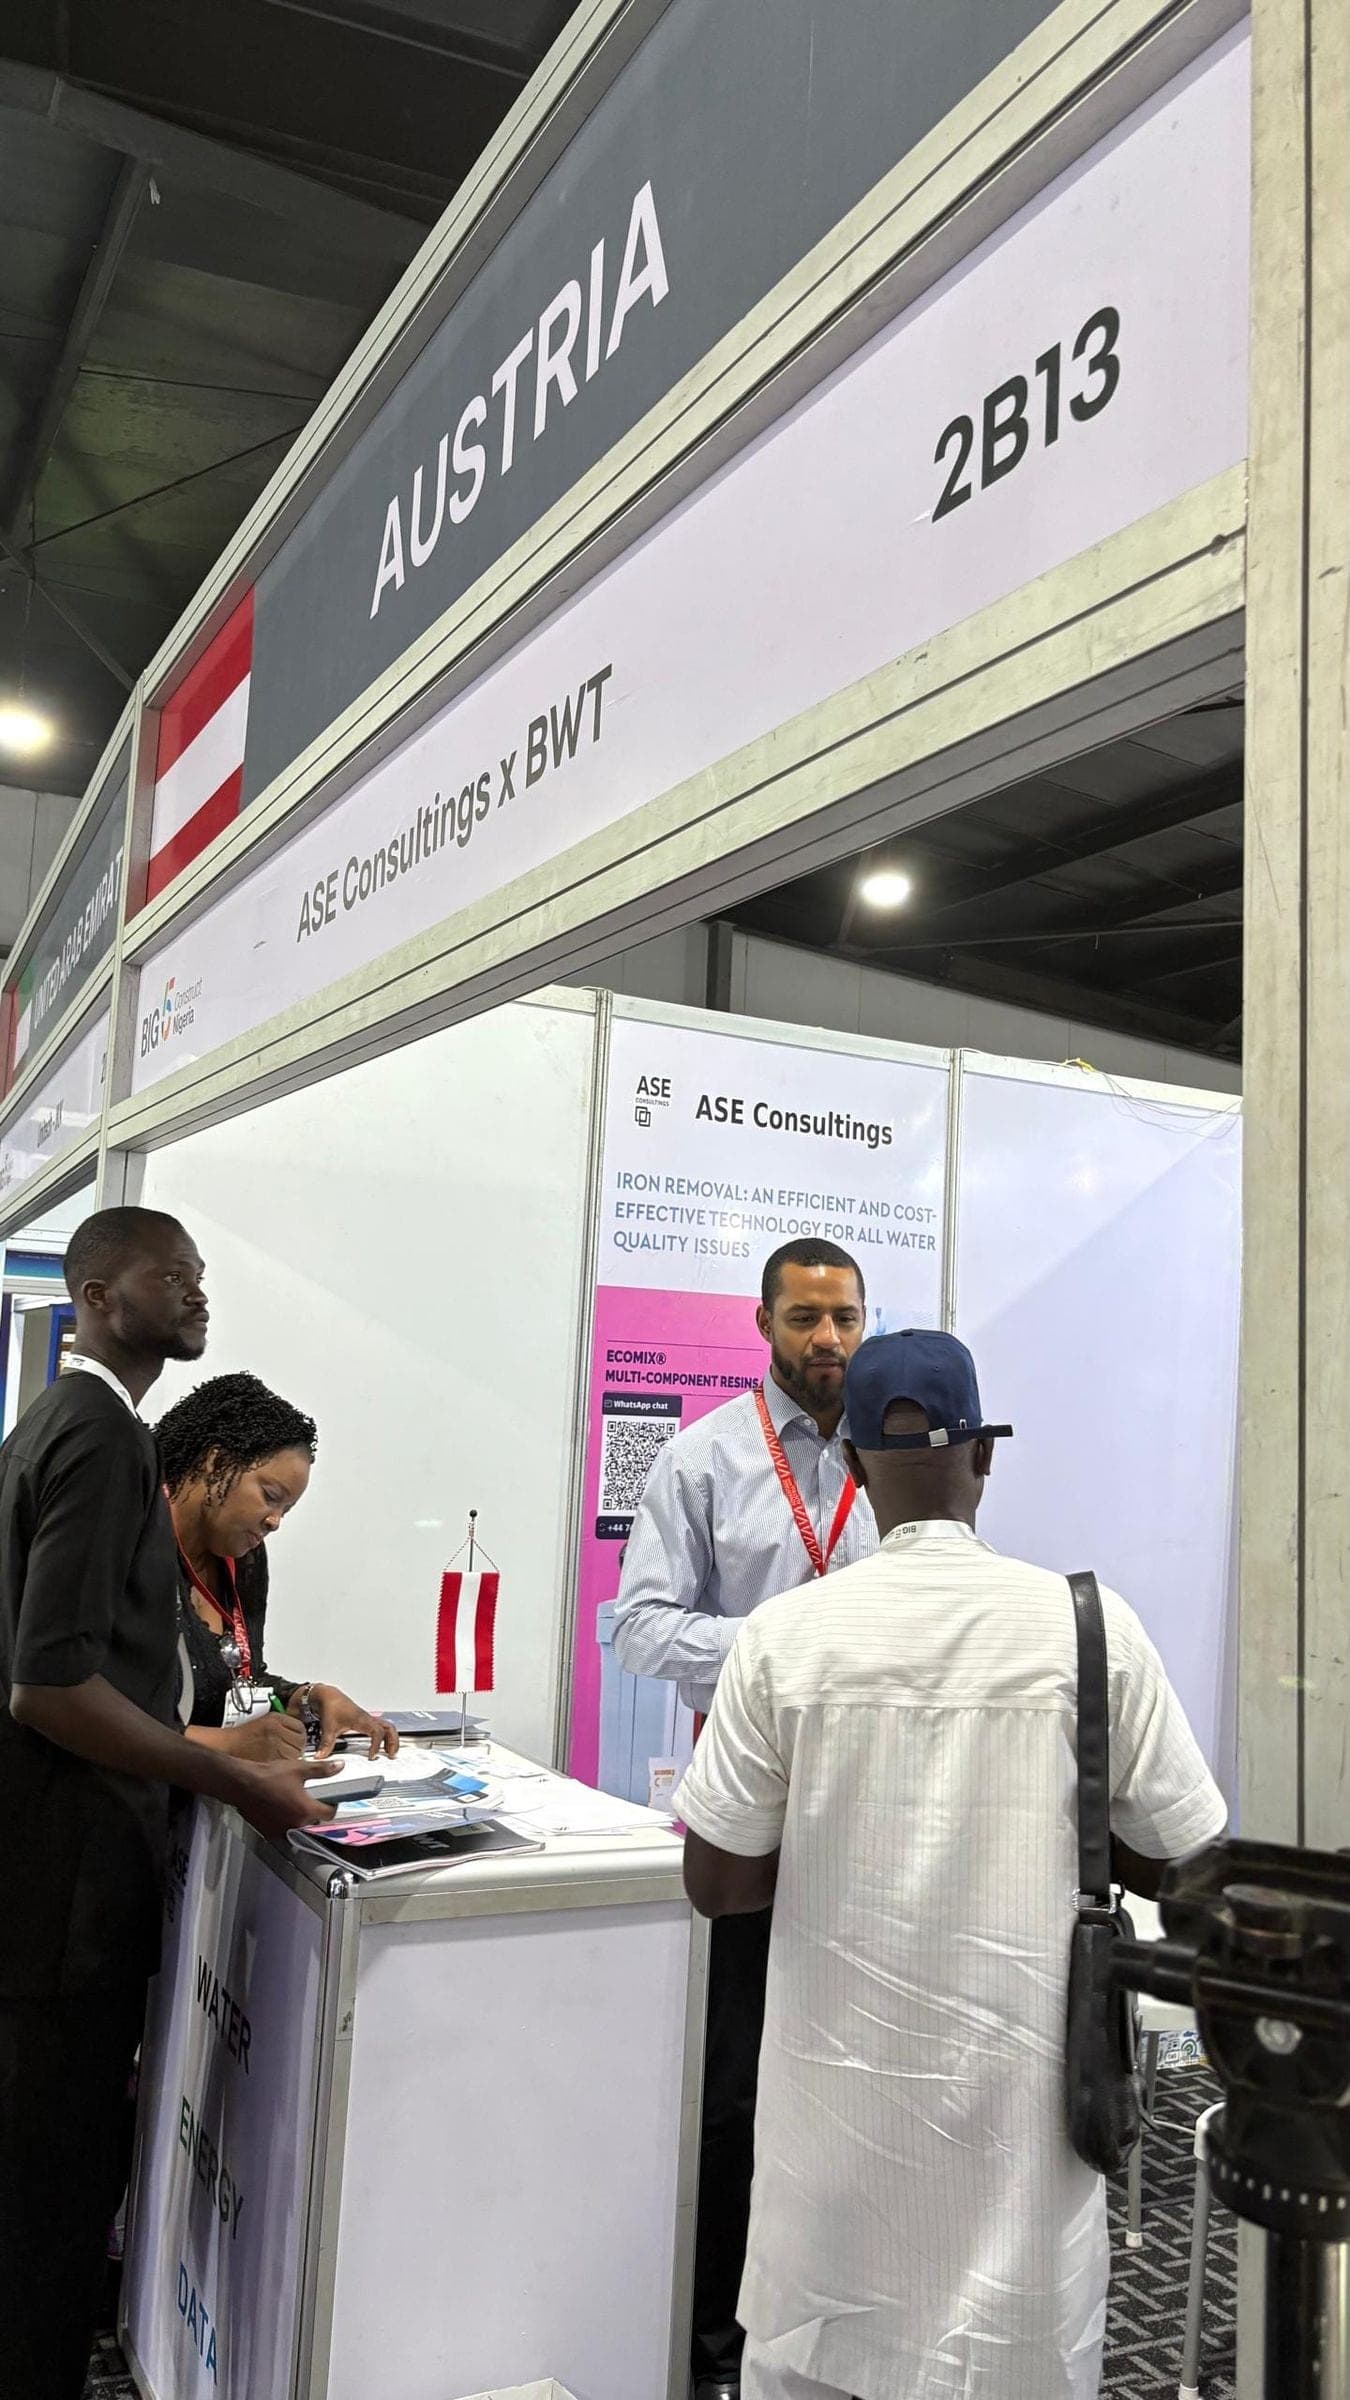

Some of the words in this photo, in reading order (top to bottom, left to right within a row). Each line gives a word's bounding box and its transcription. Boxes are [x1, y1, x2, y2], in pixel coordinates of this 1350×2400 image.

[369, 179, 670, 620] AUSTRIA
[931, 306, 1121, 524] 2B13
[297, 869, 339, 943] ASE
[342, 771, 491, 912] Consultings
[525, 663, 613, 788] BWT
[174, 976, 204, 1011] Construct
[141, 1007, 160, 1058] BIG
[173, 1005, 195, 1036] Nigeria
[636, 1075, 672, 1098] ASE
[695, 1094, 744, 1125] ASE
[753, 1101, 893, 1149] Consultings
[616, 1171, 661, 1193] IRON
[665, 1176, 748, 1201] REMOVAL:
[751, 1187, 774, 1204] AN
[777, 1189, 856, 1214] EFFICIENT
[858, 1200, 891, 1218] AND
[893, 1204, 937, 1224] COST-
[613, 1230, 689, 1253] QUALITY
[694, 1237, 751, 1258] ISSUES
[615, 1201, 706, 1226] EFFECTIVE
[708, 1210, 821, 1237] TECHNOLOGY
[824, 1222, 854, 1242] FOR
[857, 1226, 884, 1245] ALL
[886, 1229, 936, 1251] WATER
[605, 1369, 719, 1387] MULTI-COMPONENT
[720, 1375, 759, 1389] RESINS
[606, 1349, 667, 1365] ECOMIX®
[613, 1400, 651, 1410] WhatsApp
[651, 1401, 669, 1410] chat
[608, 1523, 624, 1532] +44
[197, 1954, 252, 2075] WATER
[179, 2095, 244, 2240] ENERGY
[177, 2260, 218, 2386] DATA
